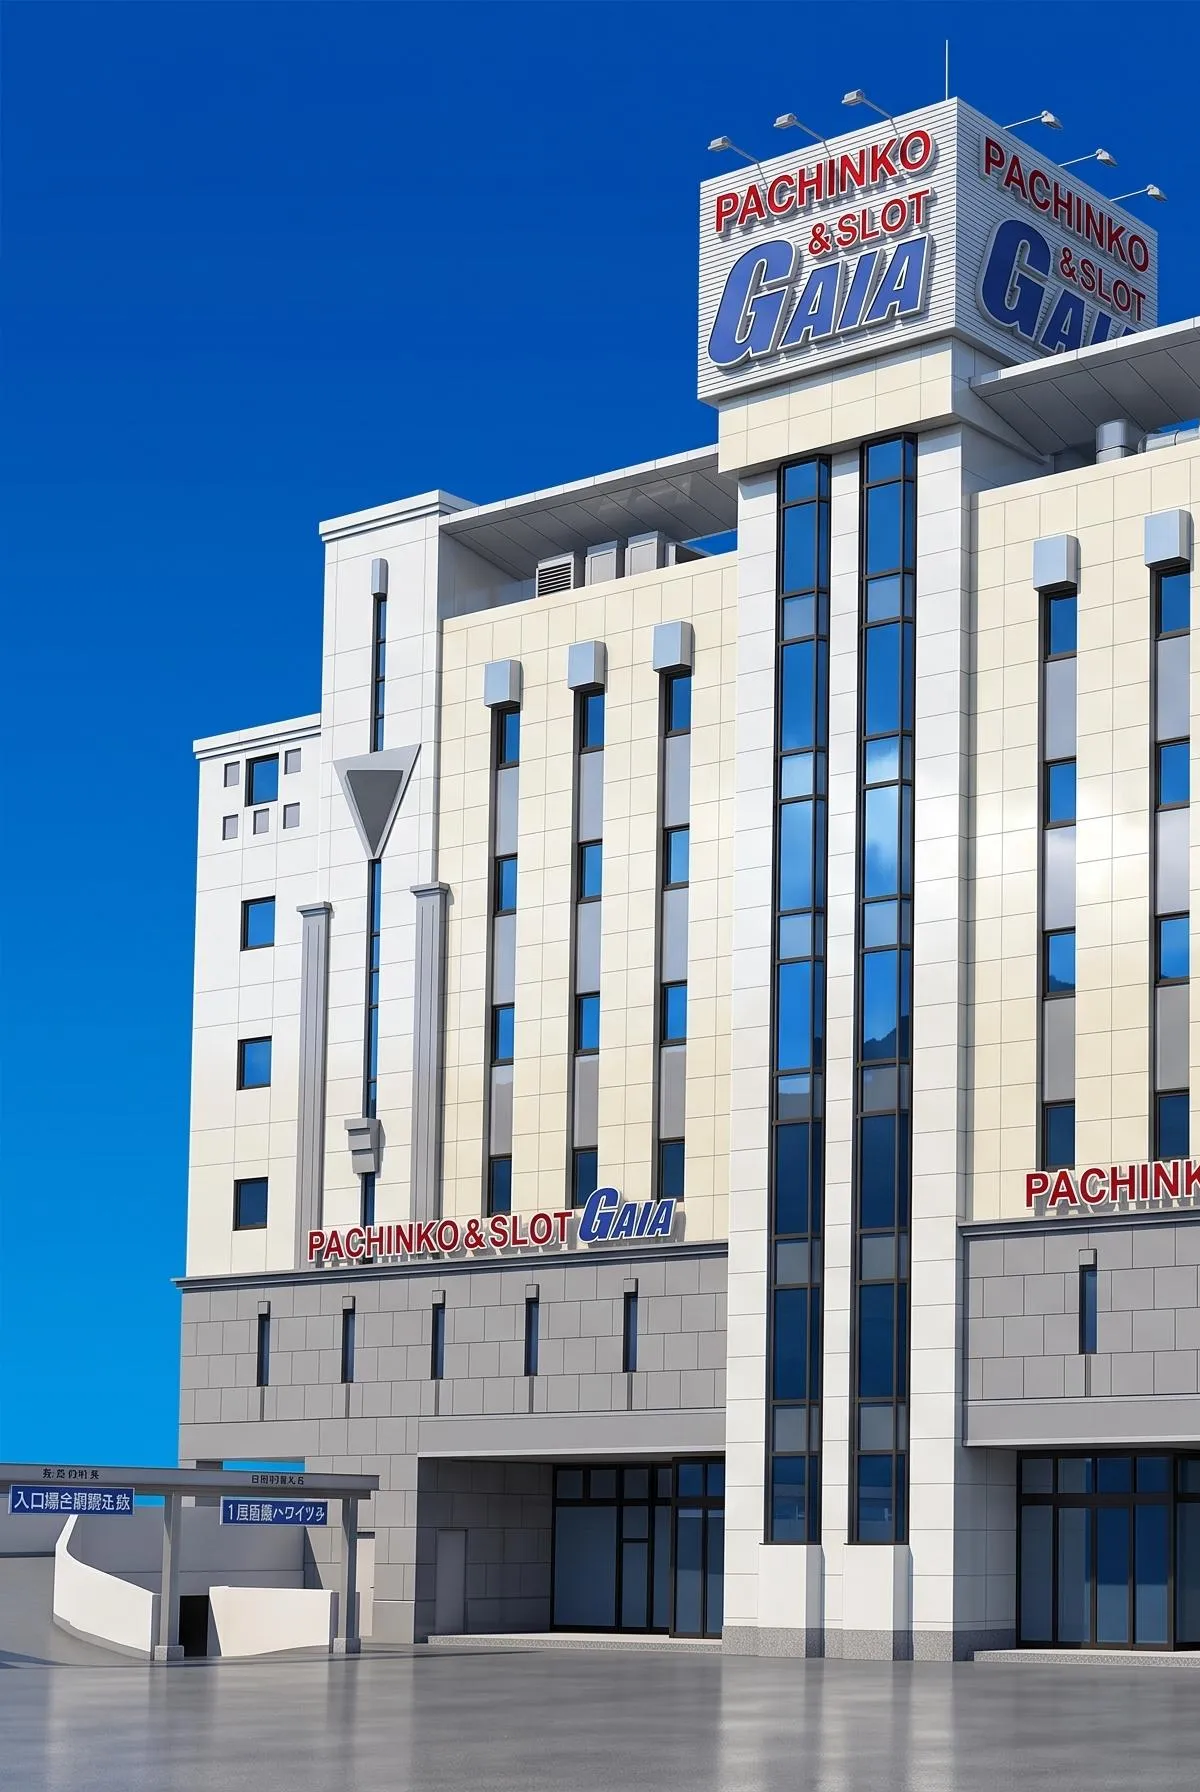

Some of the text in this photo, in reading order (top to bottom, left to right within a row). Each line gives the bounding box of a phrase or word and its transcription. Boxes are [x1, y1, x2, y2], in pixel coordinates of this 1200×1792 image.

[714, 129, 933, 234] PACHINKO
[983, 136, 1150, 274] PACHINKO
[707, 233, 930, 367] GAIA
[980, 218, 1137, 354] GAI
[576, 1185, 678, 1244] GAIA
